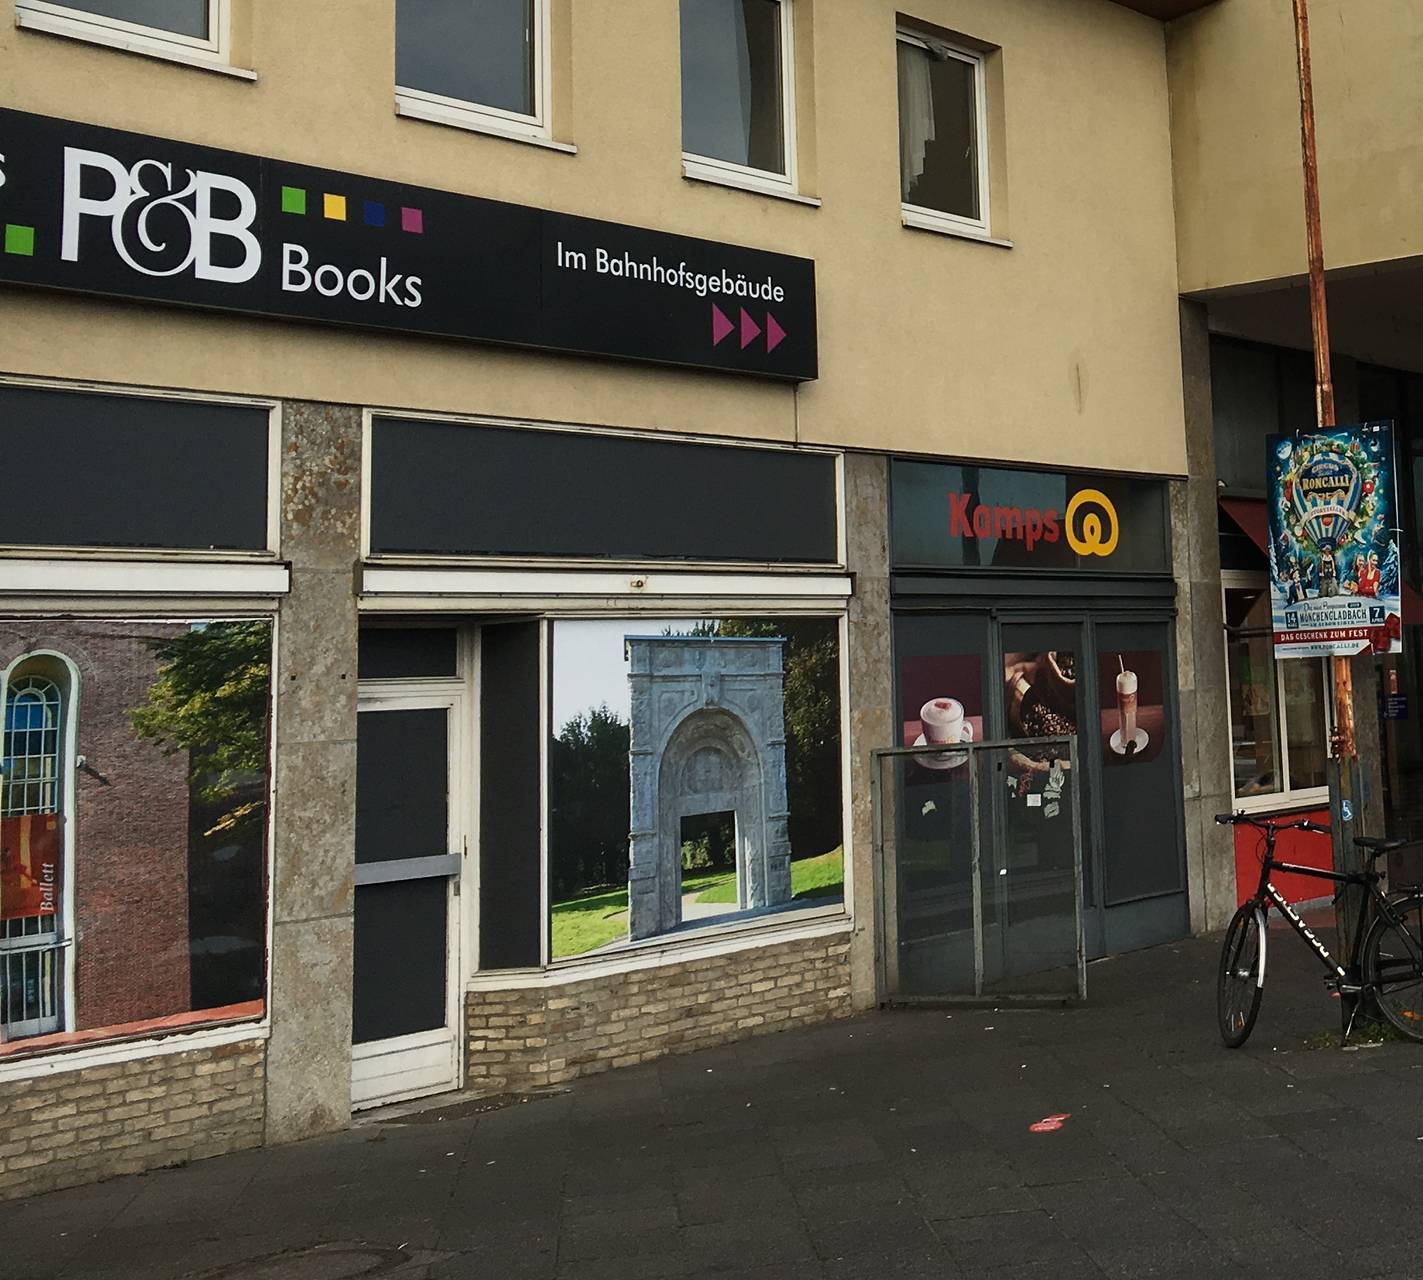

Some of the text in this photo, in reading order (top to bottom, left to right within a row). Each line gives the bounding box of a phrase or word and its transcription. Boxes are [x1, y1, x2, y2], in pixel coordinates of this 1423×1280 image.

[61, 146, 262, 284] P&B
[281, 243, 424, 308] Books
[557, 241, 785, 303] Im Bahnhofsgebäude
[1302, 474, 1351, 491] RONCALLI
[948, 492, 1060, 552] Kamps
[1330, 630, 1347, 639] ZUM
[1349, 629, 1368, 637] FEST
[1373, 608, 1380, 618] 7
[40, 863, 55, 911] Ballett
